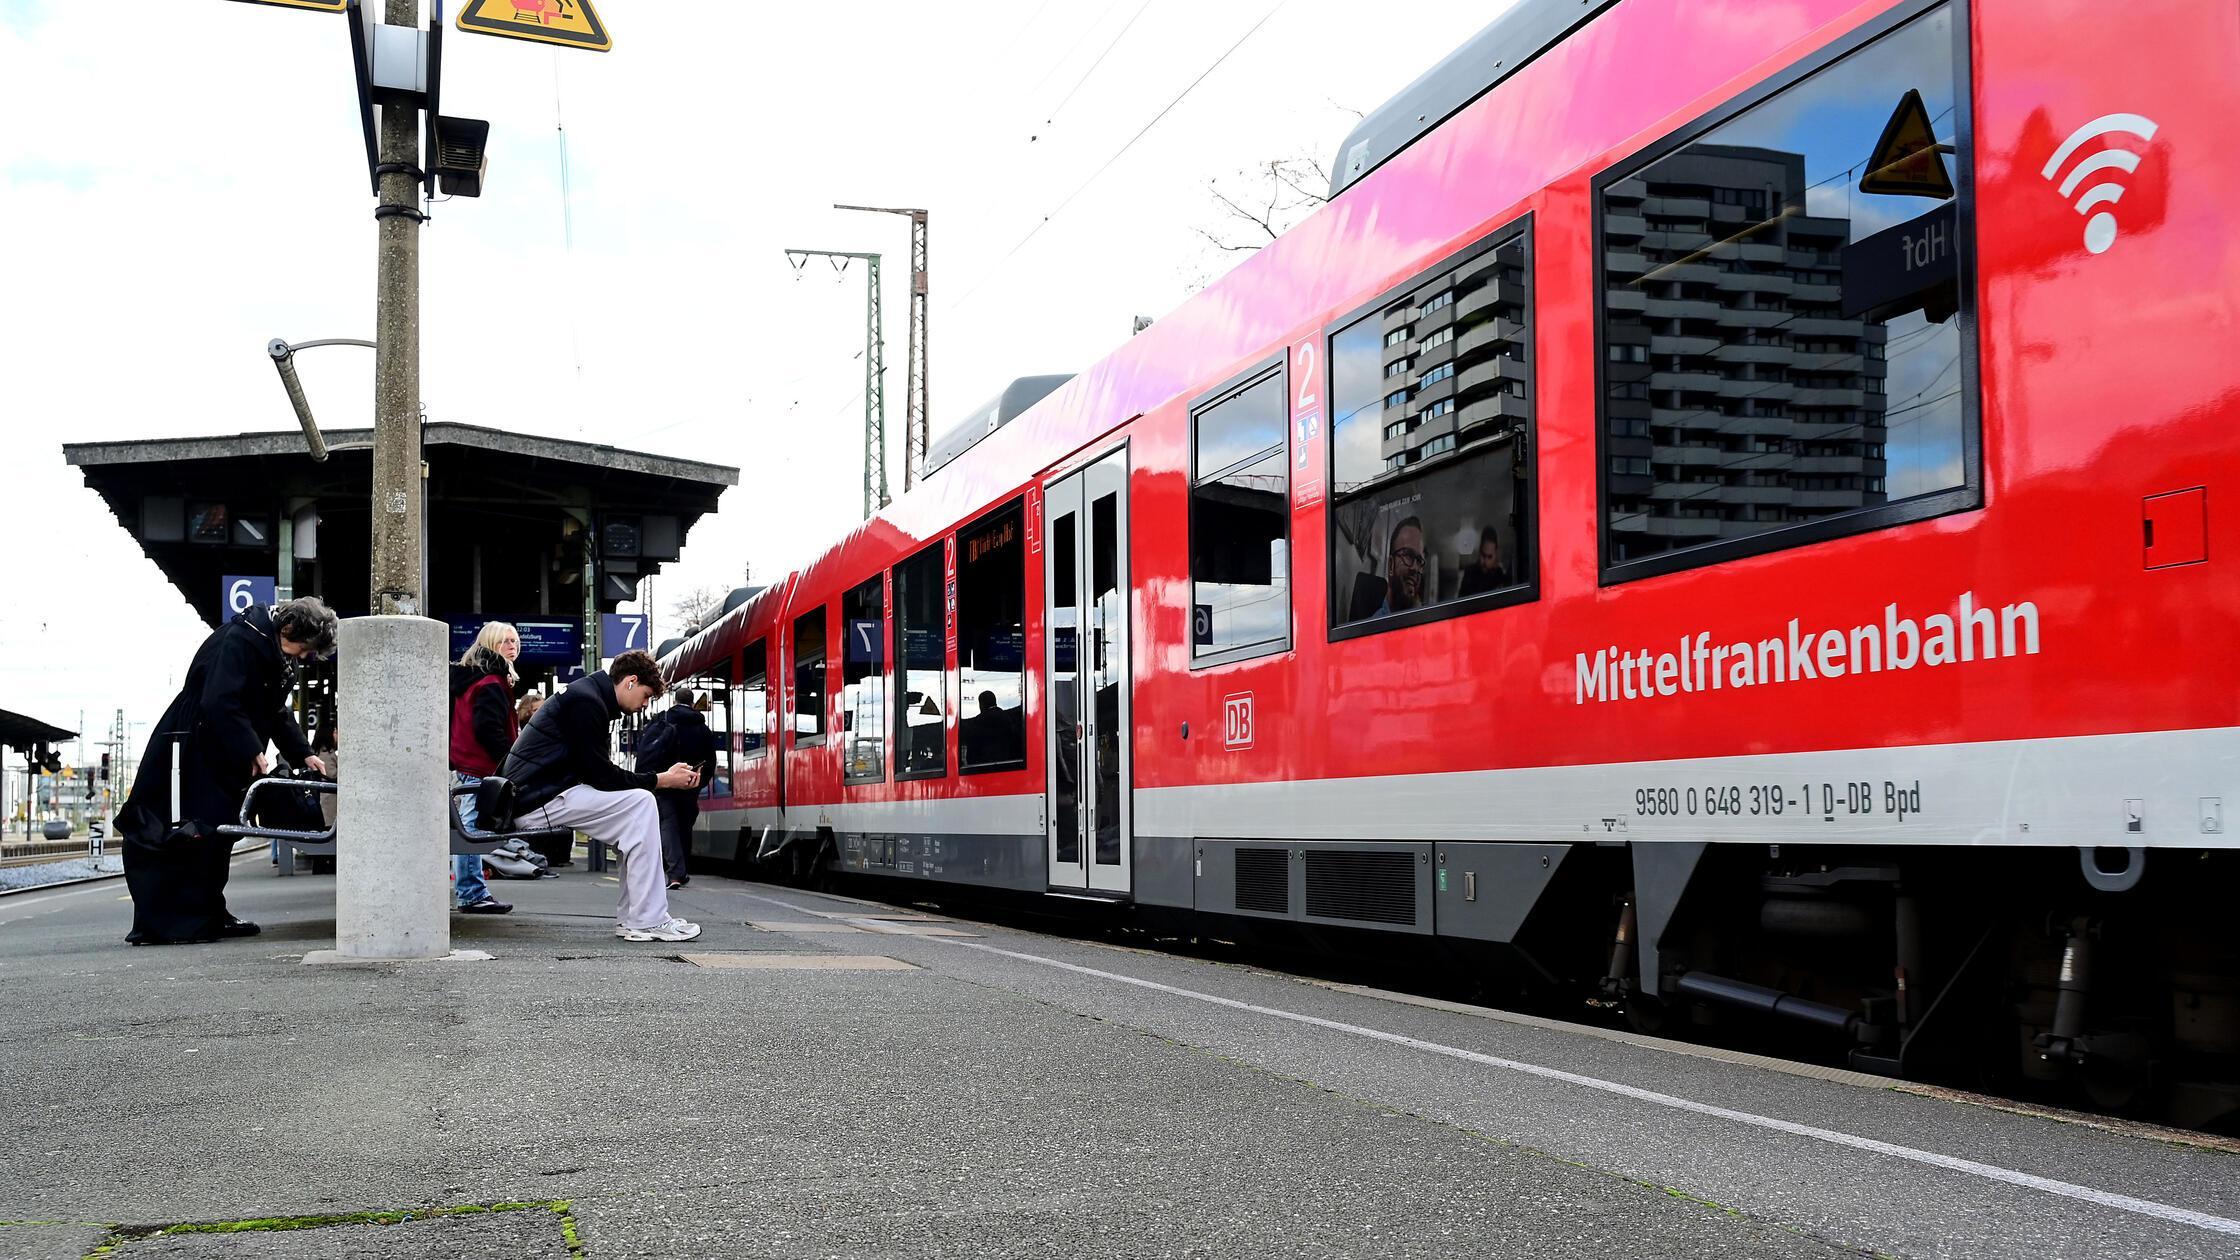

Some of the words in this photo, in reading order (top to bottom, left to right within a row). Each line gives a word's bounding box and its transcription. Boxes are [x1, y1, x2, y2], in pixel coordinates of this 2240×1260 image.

[1297, 341, 1316, 409] 2
[947, 537, 955, 577] 2
[229, 579, 254, 615] 6
[621, 617, 642, 649] 7
[1575, 590, 2040, 705] Mittelfrankenbahn
[1226, 698, 1252, 744] DB
[1635, 787, 1679, 815] 9580
[1687, 786, 1697, 815] 0
[1705, 786, 1741, 815] 648
[1823, 781, 1872, 821] D-DB
[1884, 780, 1920, 822] Bpd
[90, 839, 102, 855] H
